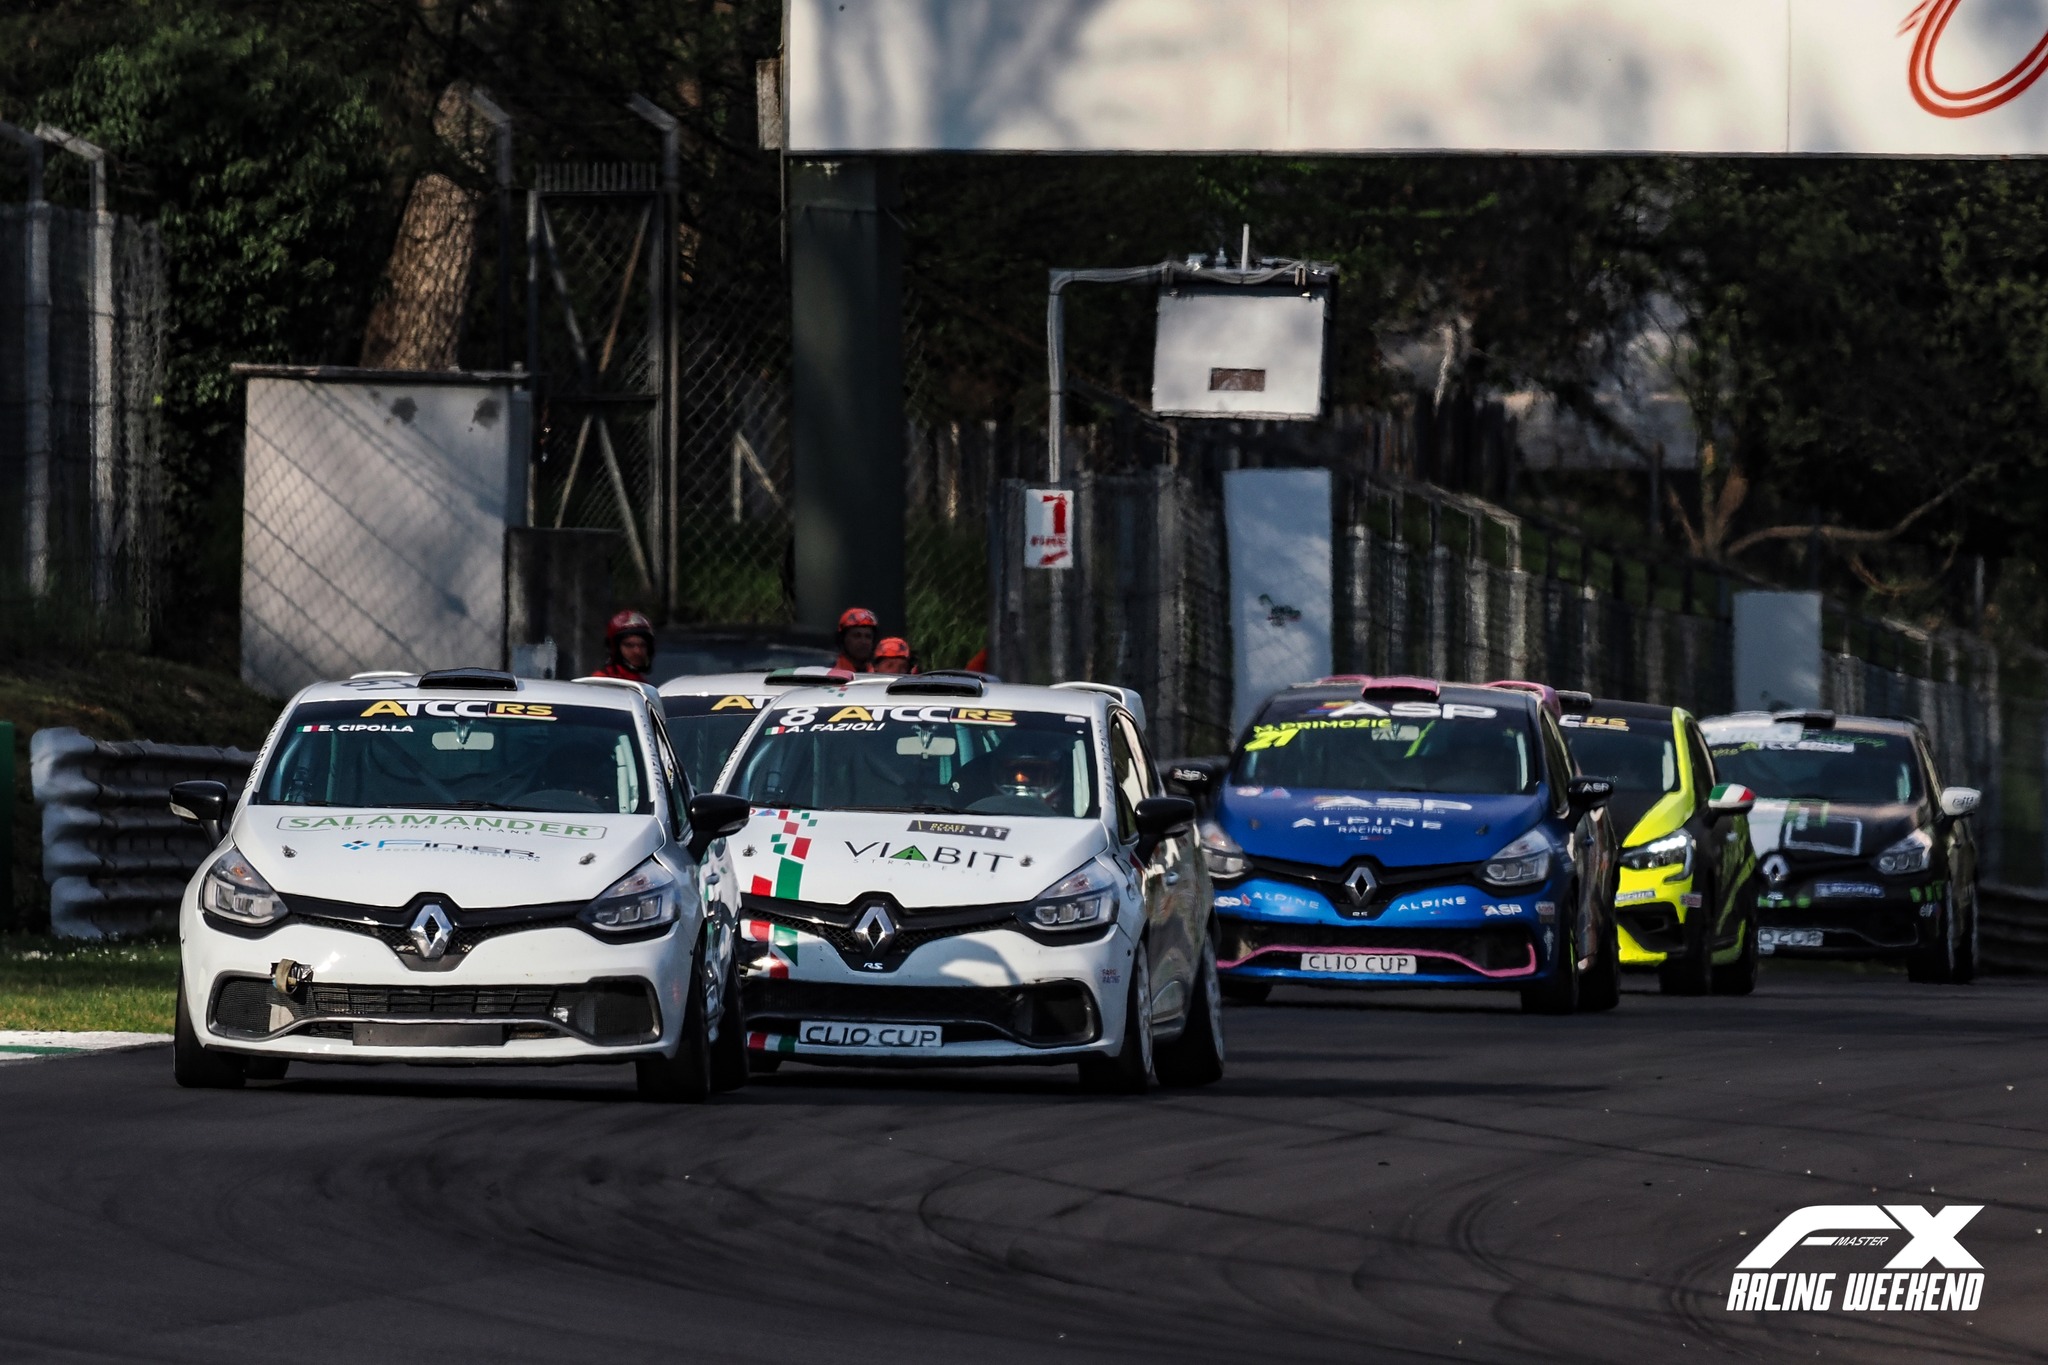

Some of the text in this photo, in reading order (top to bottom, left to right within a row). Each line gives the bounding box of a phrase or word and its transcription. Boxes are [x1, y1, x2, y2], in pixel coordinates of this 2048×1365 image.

[779, 707, 819, 726] 8
[1328, 702, 1497, 719] ASP
[337, 725, 414, 733] CIPOLLA
[810, 722, 886, 732] FAZIOLI
[1582, 783, 1609, 793] ASP
[289, 815, 588, 836] SALAMANDER
[1293, 816, 1442, 830] ALPINE
[444, 826, 532, 835] ITALIANE
[1338, 826, 1392, 835] RACING
[844, 841, 1014, 873] VIABIT
[853, 858, 948, 871] STRADE
[1214, 896, 1241, 907] SP
[1253, 892, 1320, 909] ALPINE
[1398, 896, 1467, 911] ALPINE
[1485, 904, 1523, 917] ASP
[863, 962, 884, 970] RS
[1309, 955, 1408, 972] CLIO CUP
[805, 1026, 938, 1047] CLIO CUP
